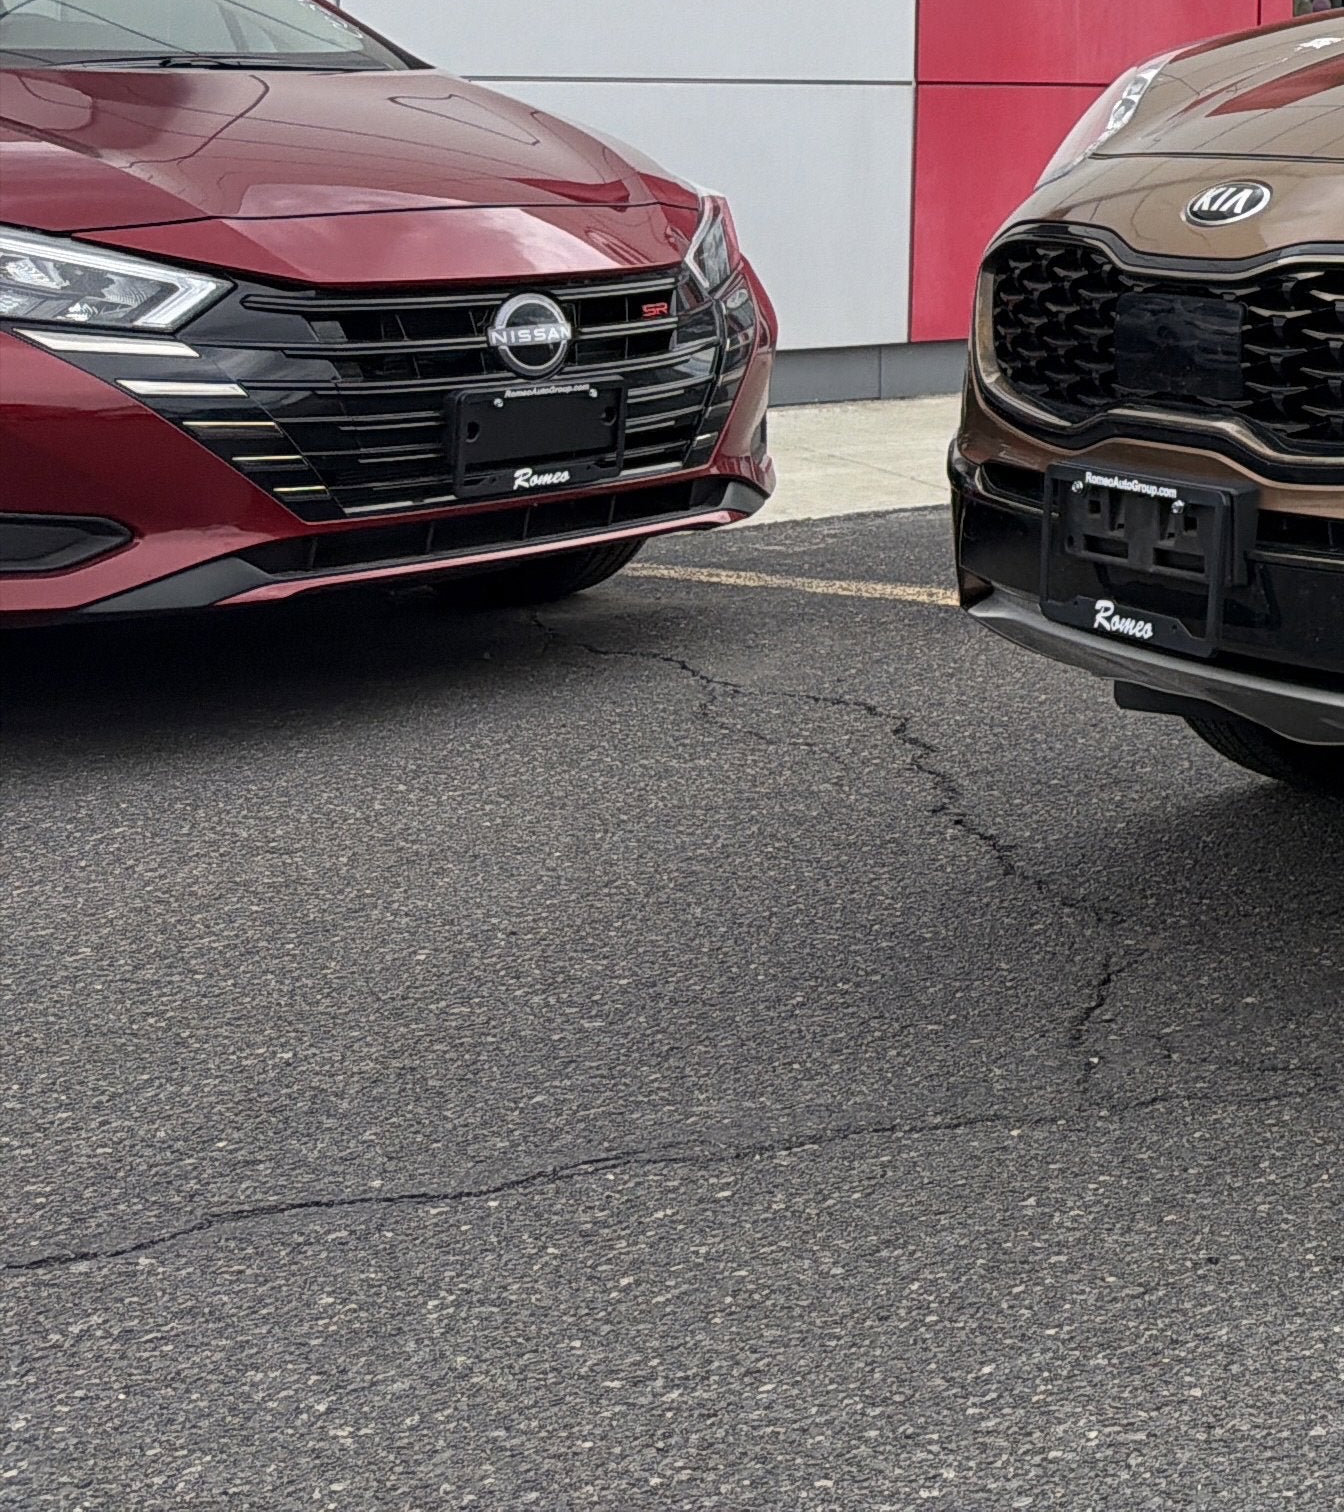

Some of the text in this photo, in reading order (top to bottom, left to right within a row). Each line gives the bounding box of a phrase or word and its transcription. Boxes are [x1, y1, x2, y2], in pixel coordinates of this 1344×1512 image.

[1193, 187, 1253, 214] KIA
[642, 302, 667, 318] SR
[490, 326, 571, 345] NISSAN
[504, 384, 590, 398] RomeoAutoGroup.com
[513, 467, 570, 490] Romeo
[1085, 471, 1177, 498] RomeoAutoGroup.com
[1093, 599, 1153, 639] Romeo
